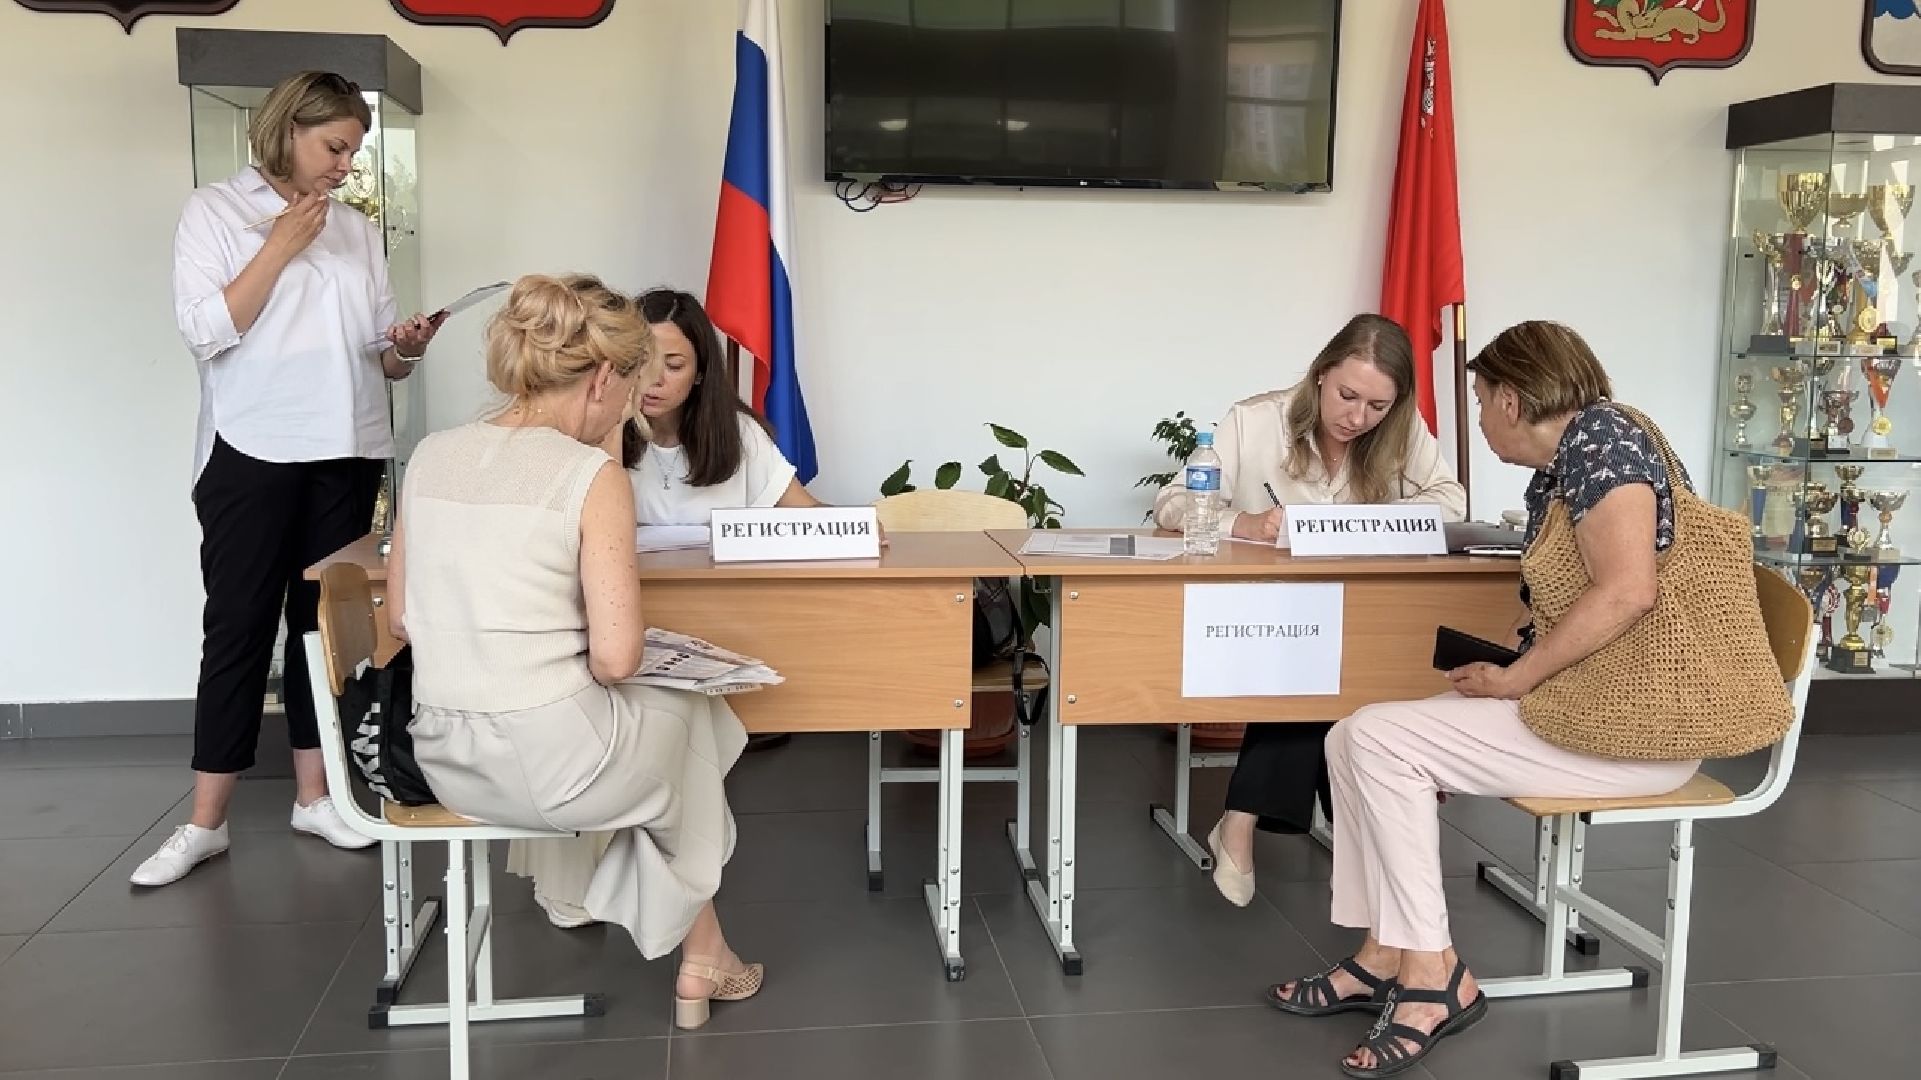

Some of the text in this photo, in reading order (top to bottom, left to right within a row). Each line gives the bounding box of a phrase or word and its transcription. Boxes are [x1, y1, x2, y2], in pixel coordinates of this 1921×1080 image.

[721, 521, 870, 538] РЕГИСТРАЦИЯ
[1295, 518, 1437, 535] РЕГИСТРАЦИЯ
[1205, 624, 1319, 638] РЕГИСТРАЦИЯ
